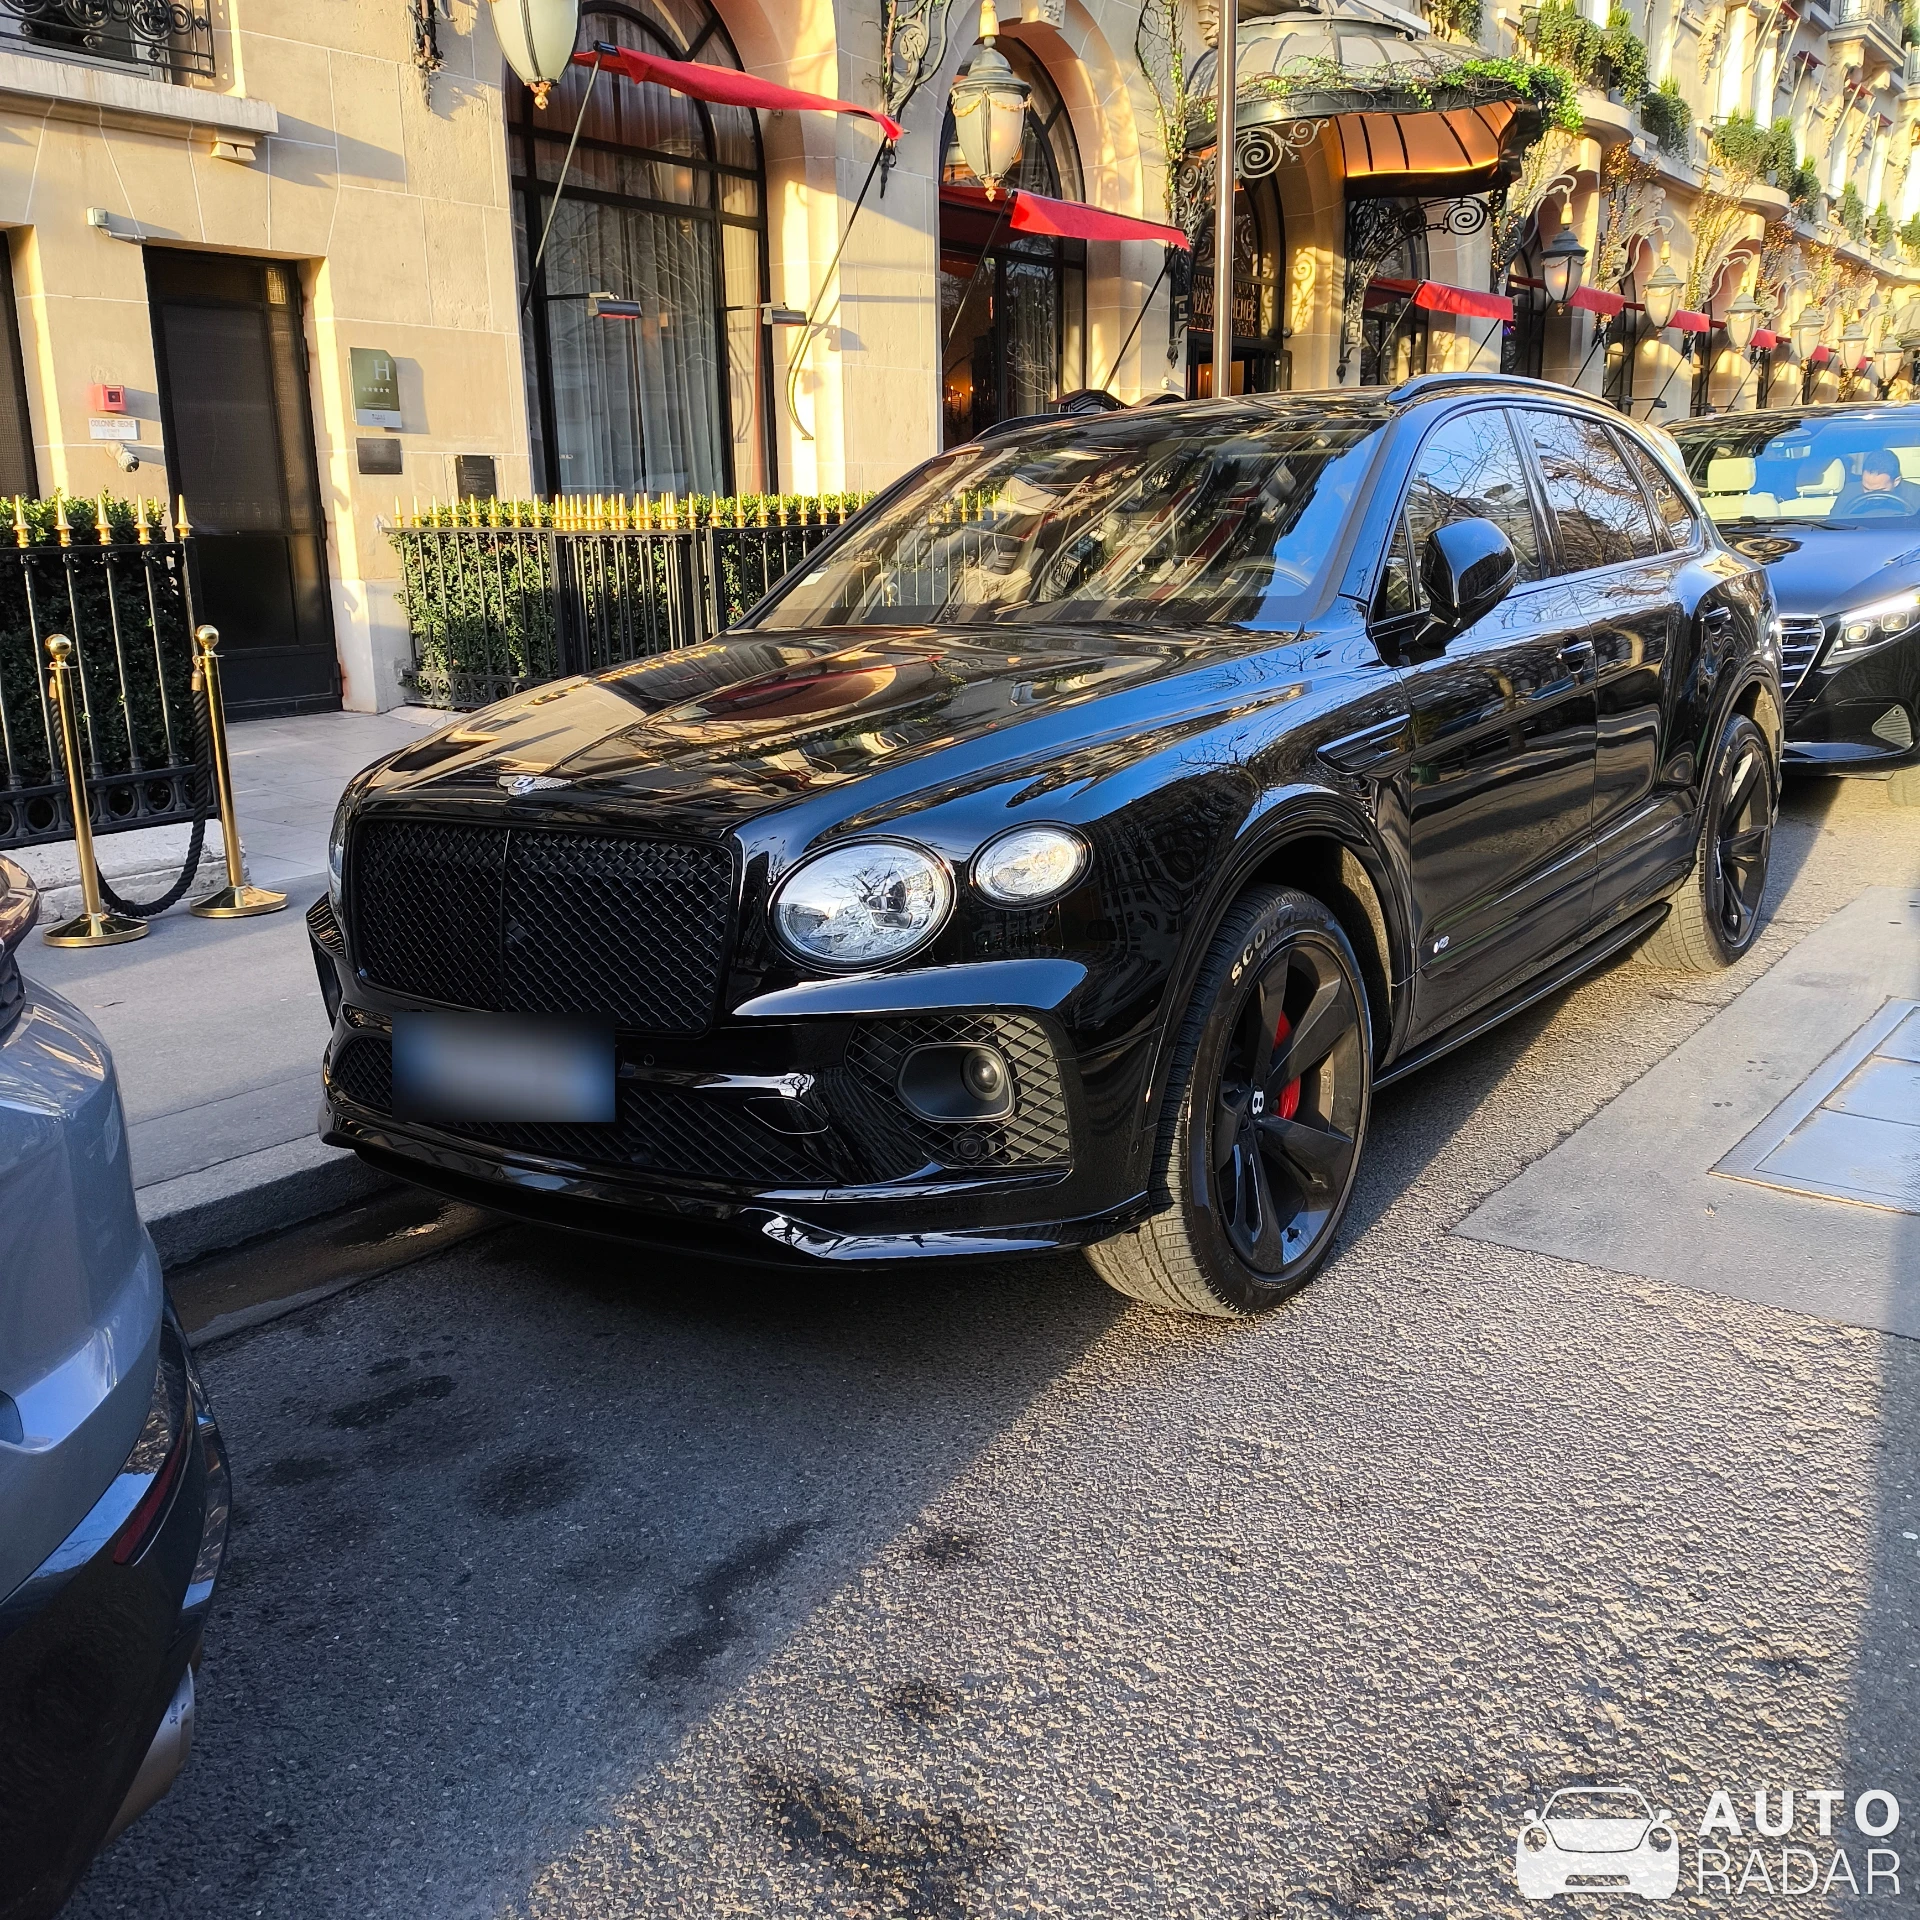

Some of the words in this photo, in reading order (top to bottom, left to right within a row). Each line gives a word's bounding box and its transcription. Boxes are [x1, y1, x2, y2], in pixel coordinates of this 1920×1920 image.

[373, 359, 391, 381] H
[1260, 926, 1296, 959] WINTER
[1433, 935, 1450, 954] V8
[1252, 1090, 1264, 1115] B
